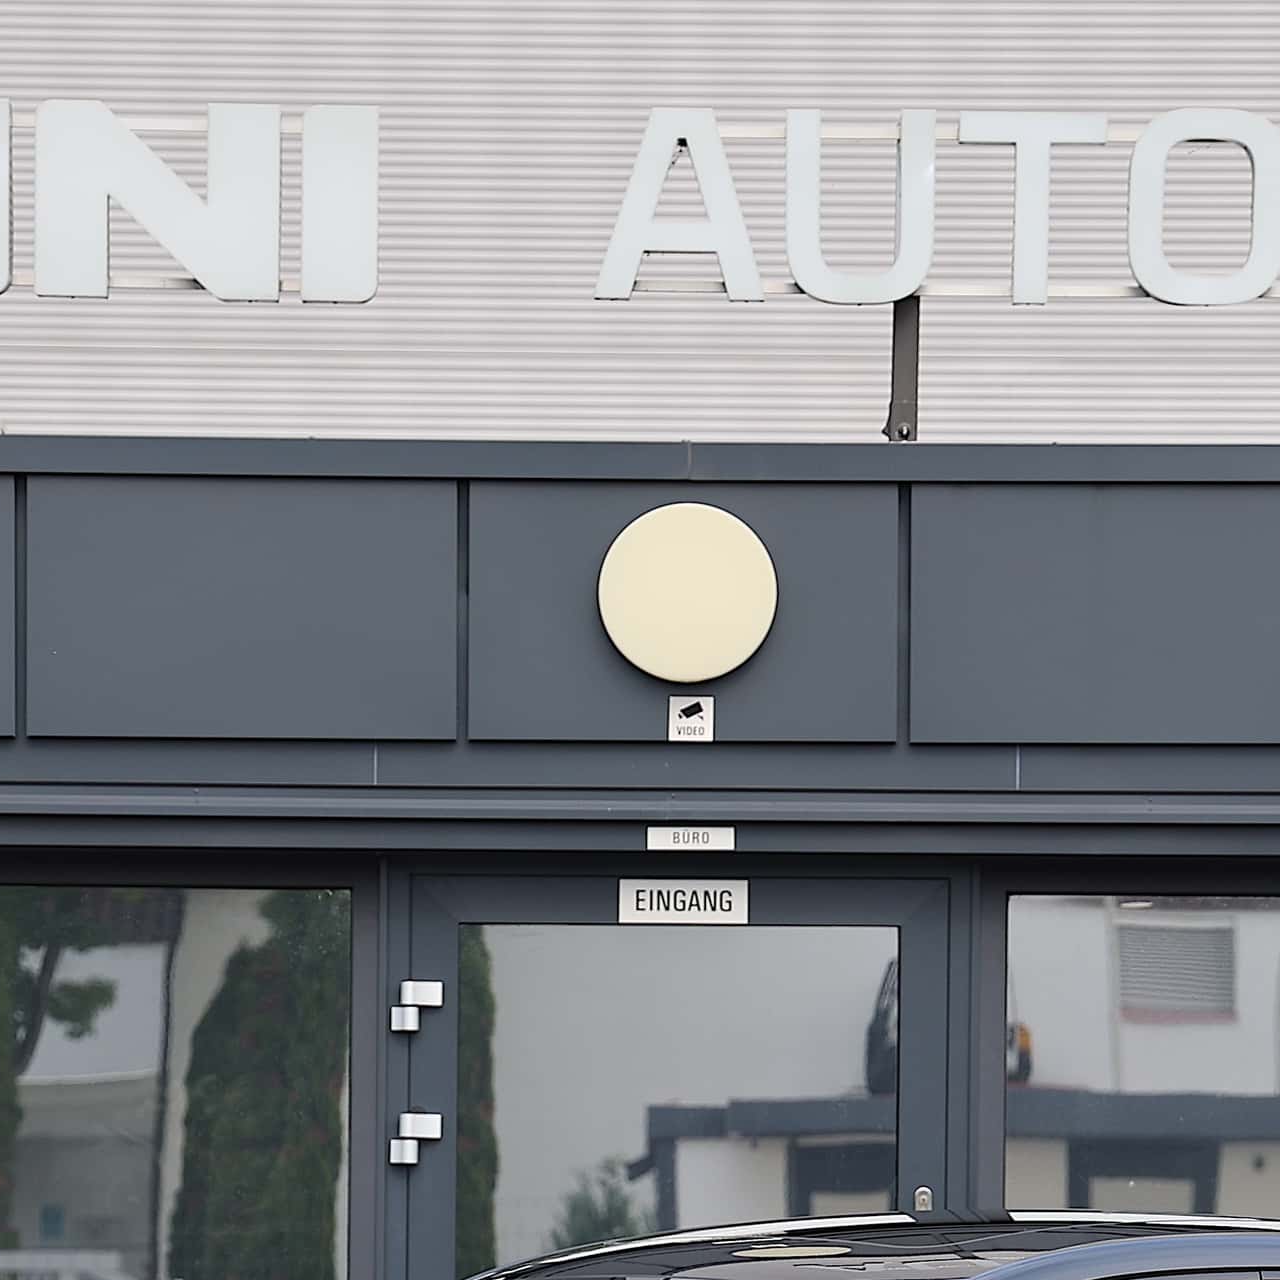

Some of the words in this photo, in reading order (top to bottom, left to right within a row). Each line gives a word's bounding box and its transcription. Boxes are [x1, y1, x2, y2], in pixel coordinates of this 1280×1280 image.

[676, 725, 705, 736] VIDEO
[672, 828, 710, 845] BÜRO
[635, 889, 733, 912] EINGANG
